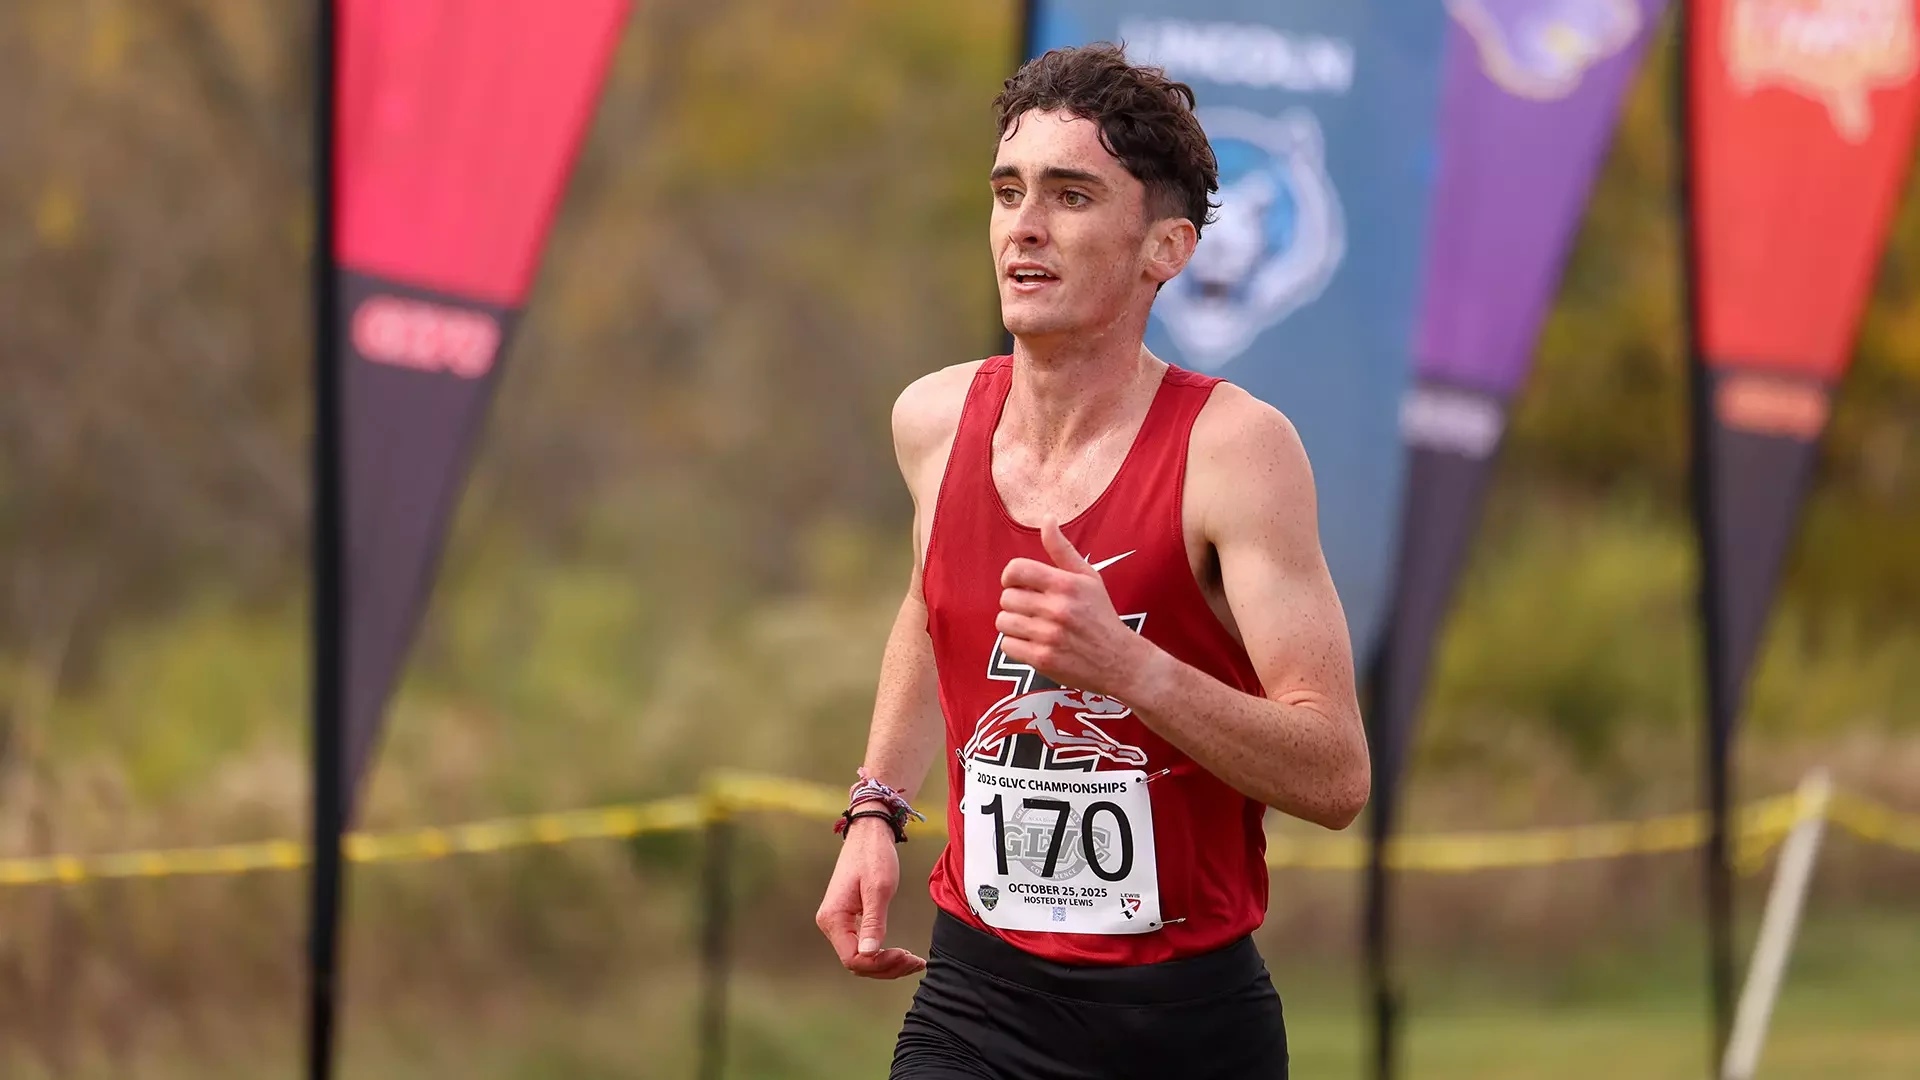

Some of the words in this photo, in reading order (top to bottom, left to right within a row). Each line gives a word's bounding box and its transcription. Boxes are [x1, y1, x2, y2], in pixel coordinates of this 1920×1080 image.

[977, 772, 997, 786] 2025
[998, 776, 1026, 789] GLVC
[1028, 779, 1128, 794] CHAMPIONSHIPS
[981, 794, 1134, 882] 170
[1008, 883, 1060, 896] OCTOBER
[1062, 886, 1079, 898] 25,
[1080, 887, 1108, 898] 2025
[1024, 896, 1057, 905] HOSTED
[1058, 897, 1068, 906] BY
[1069, 898, 1094, 907] LEWIS
